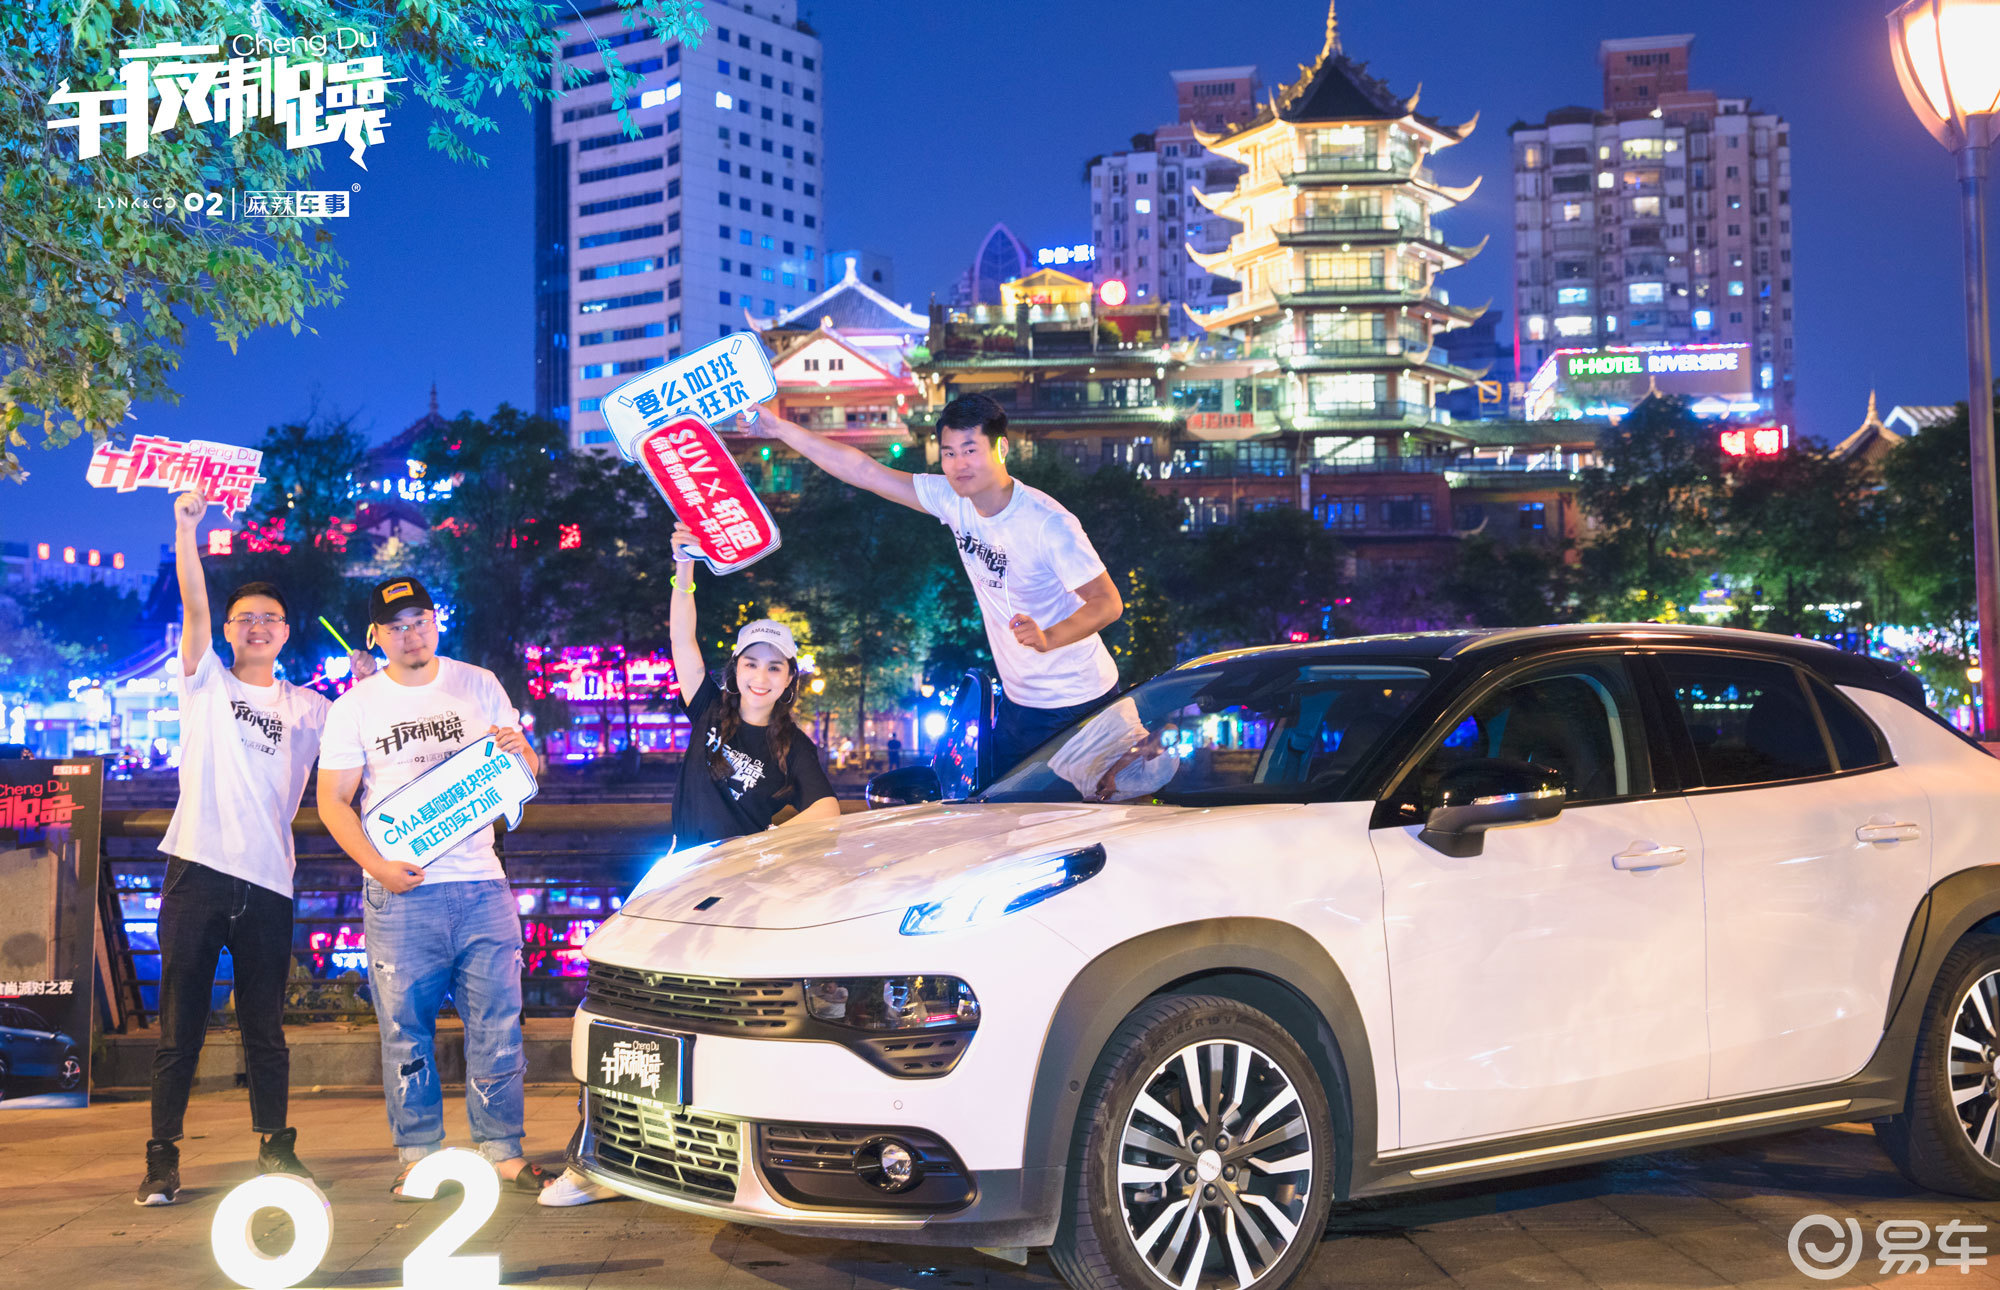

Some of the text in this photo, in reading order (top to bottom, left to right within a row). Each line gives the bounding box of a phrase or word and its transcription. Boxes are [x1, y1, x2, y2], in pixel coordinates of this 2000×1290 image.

[1569, 352, 1738, 375] H-HOTEL RIVERSIDE
[633, 352, 738, 419] 要么加班
[189, 441, 257, 462] Cheng Du
[669, 428, 719, 473] SUV
[711, 497, 763, 551] 轿跑
[751, 628, 781, 636] AMAZING
[416, 710, 457, 723] Cheng Du
[48, 780, 69, 792] Du
[384, 754, 511, 845] CMA基础模块架构
[408, 786, 502, 857] 真正的实力派
[1195, 1018, 1205, 1028] R
[632, 1040, 660, 1052] Cheng Du
